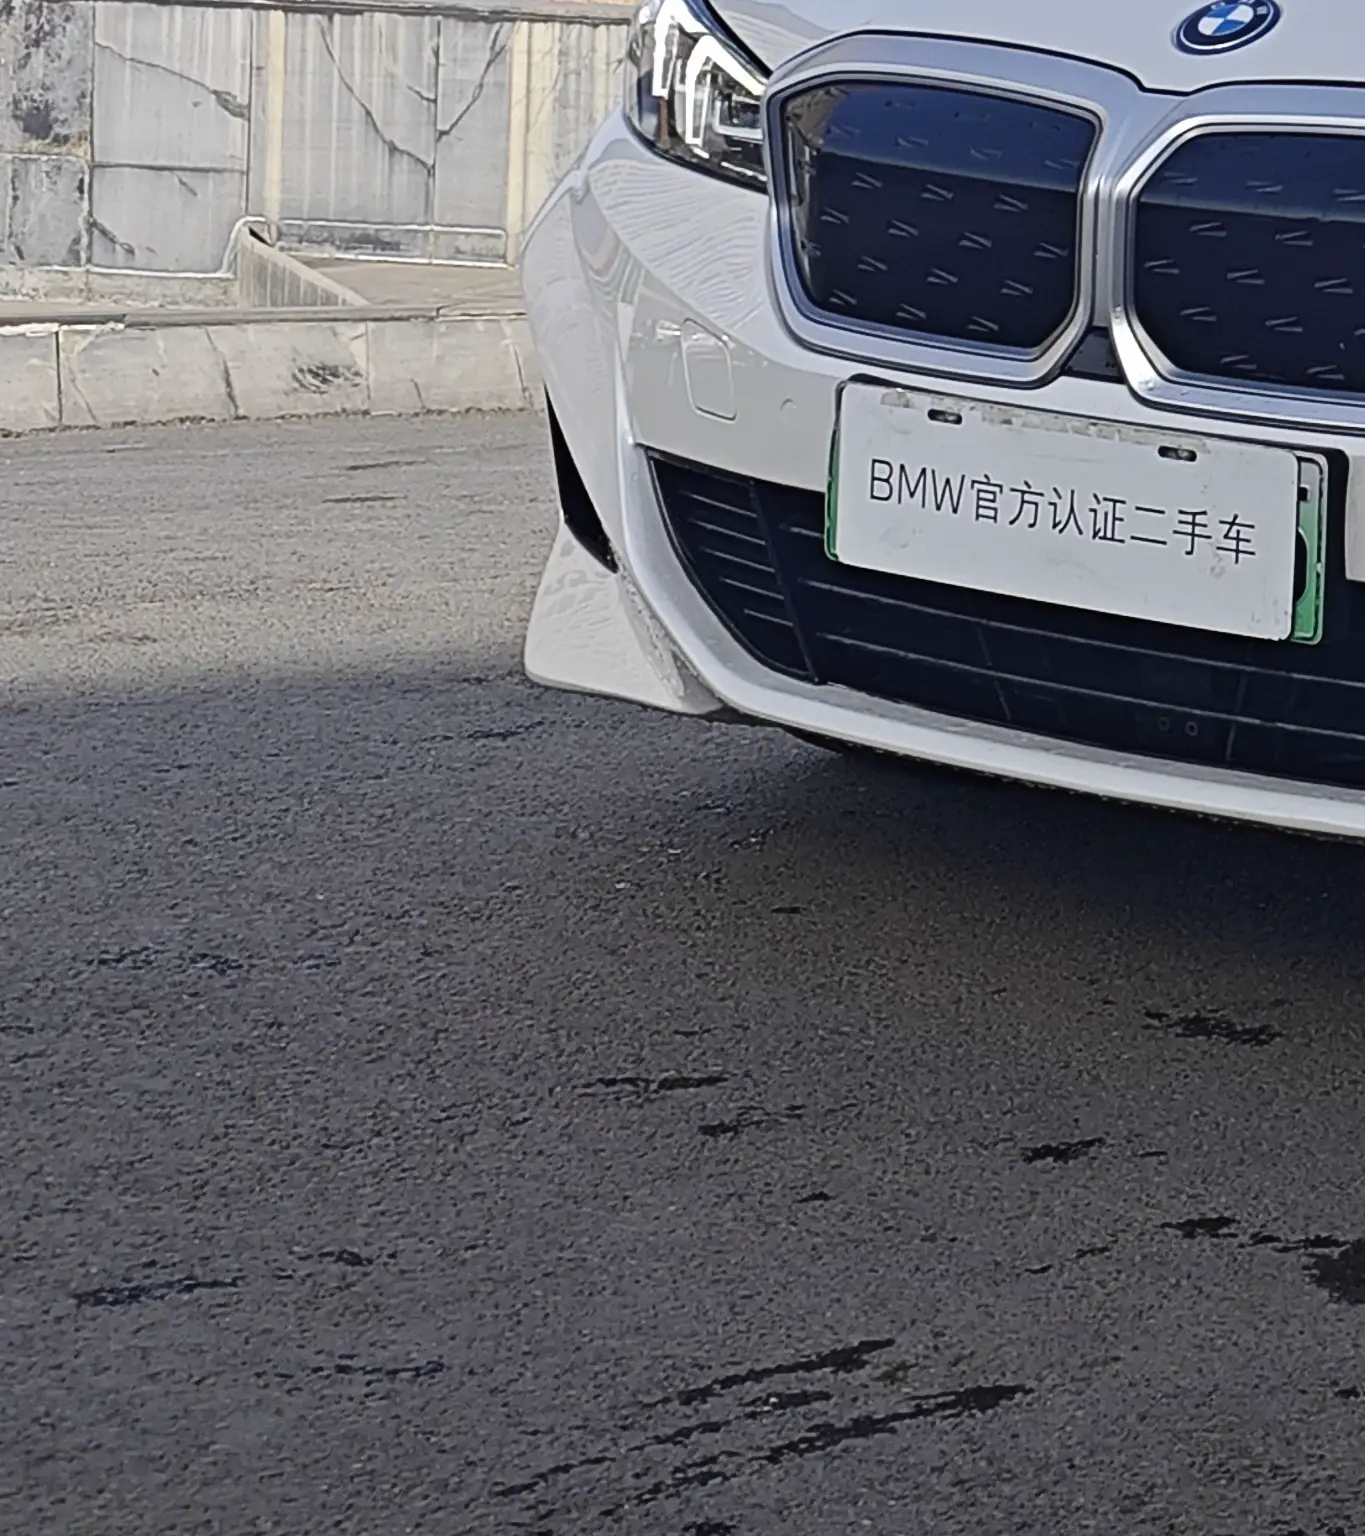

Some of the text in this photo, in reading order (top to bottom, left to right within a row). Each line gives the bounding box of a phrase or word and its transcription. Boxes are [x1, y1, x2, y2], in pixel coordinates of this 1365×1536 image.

[869, 457, 1257, 565] BMW官方认证二手车
